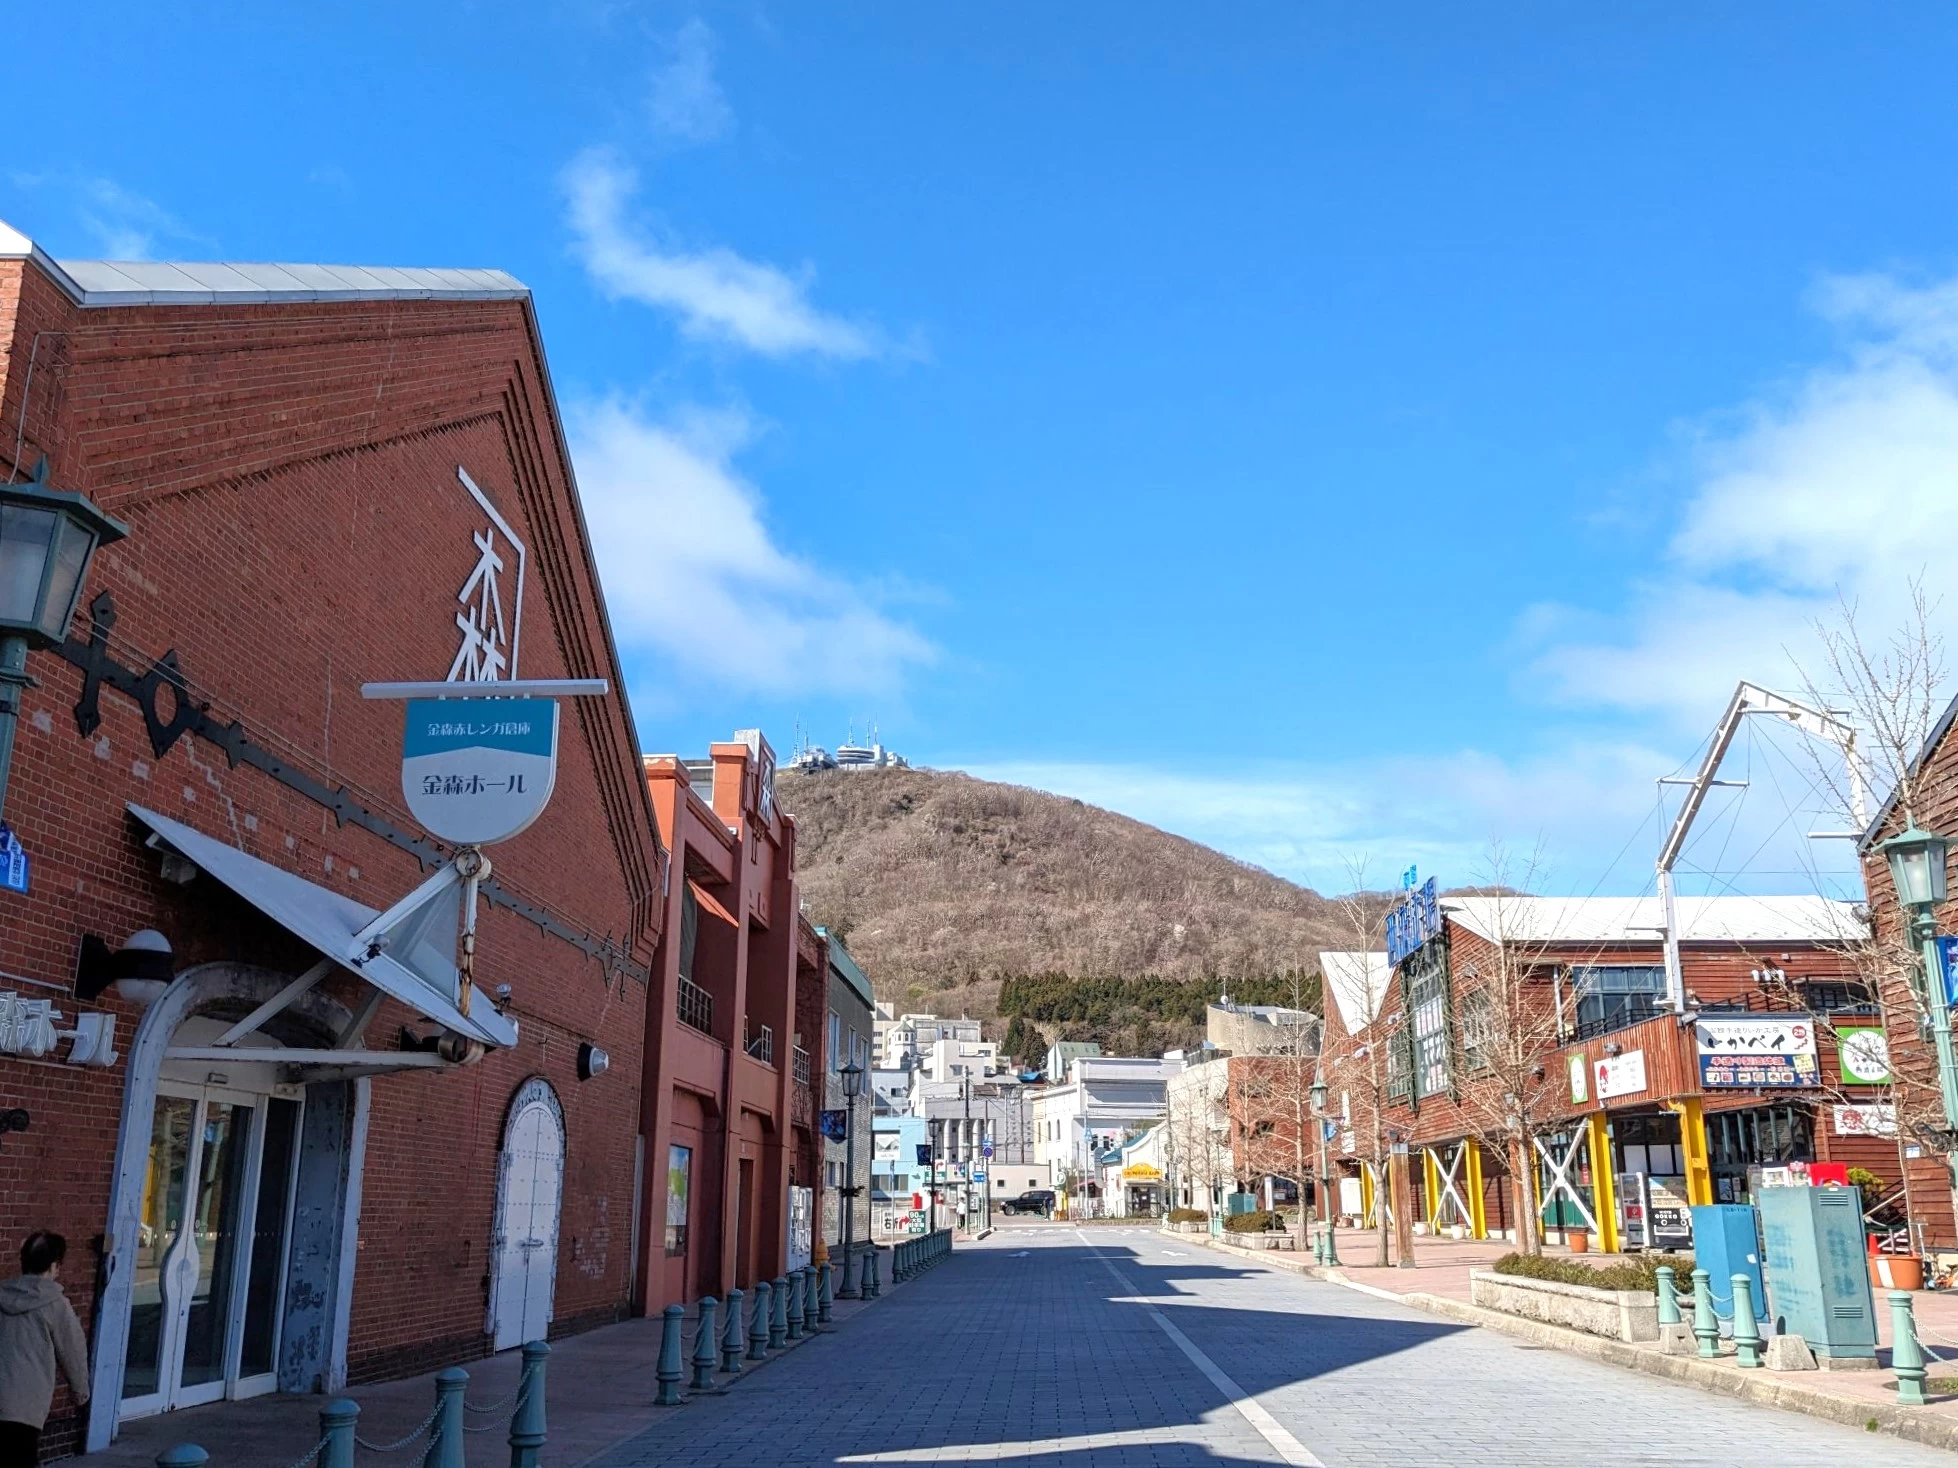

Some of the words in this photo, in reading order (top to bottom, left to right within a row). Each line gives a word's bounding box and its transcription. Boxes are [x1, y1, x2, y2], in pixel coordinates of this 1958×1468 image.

[427, 721, 531, 737] 金森赤レンガ倉庫
[421, 773, 528, 797] 金森ホール
